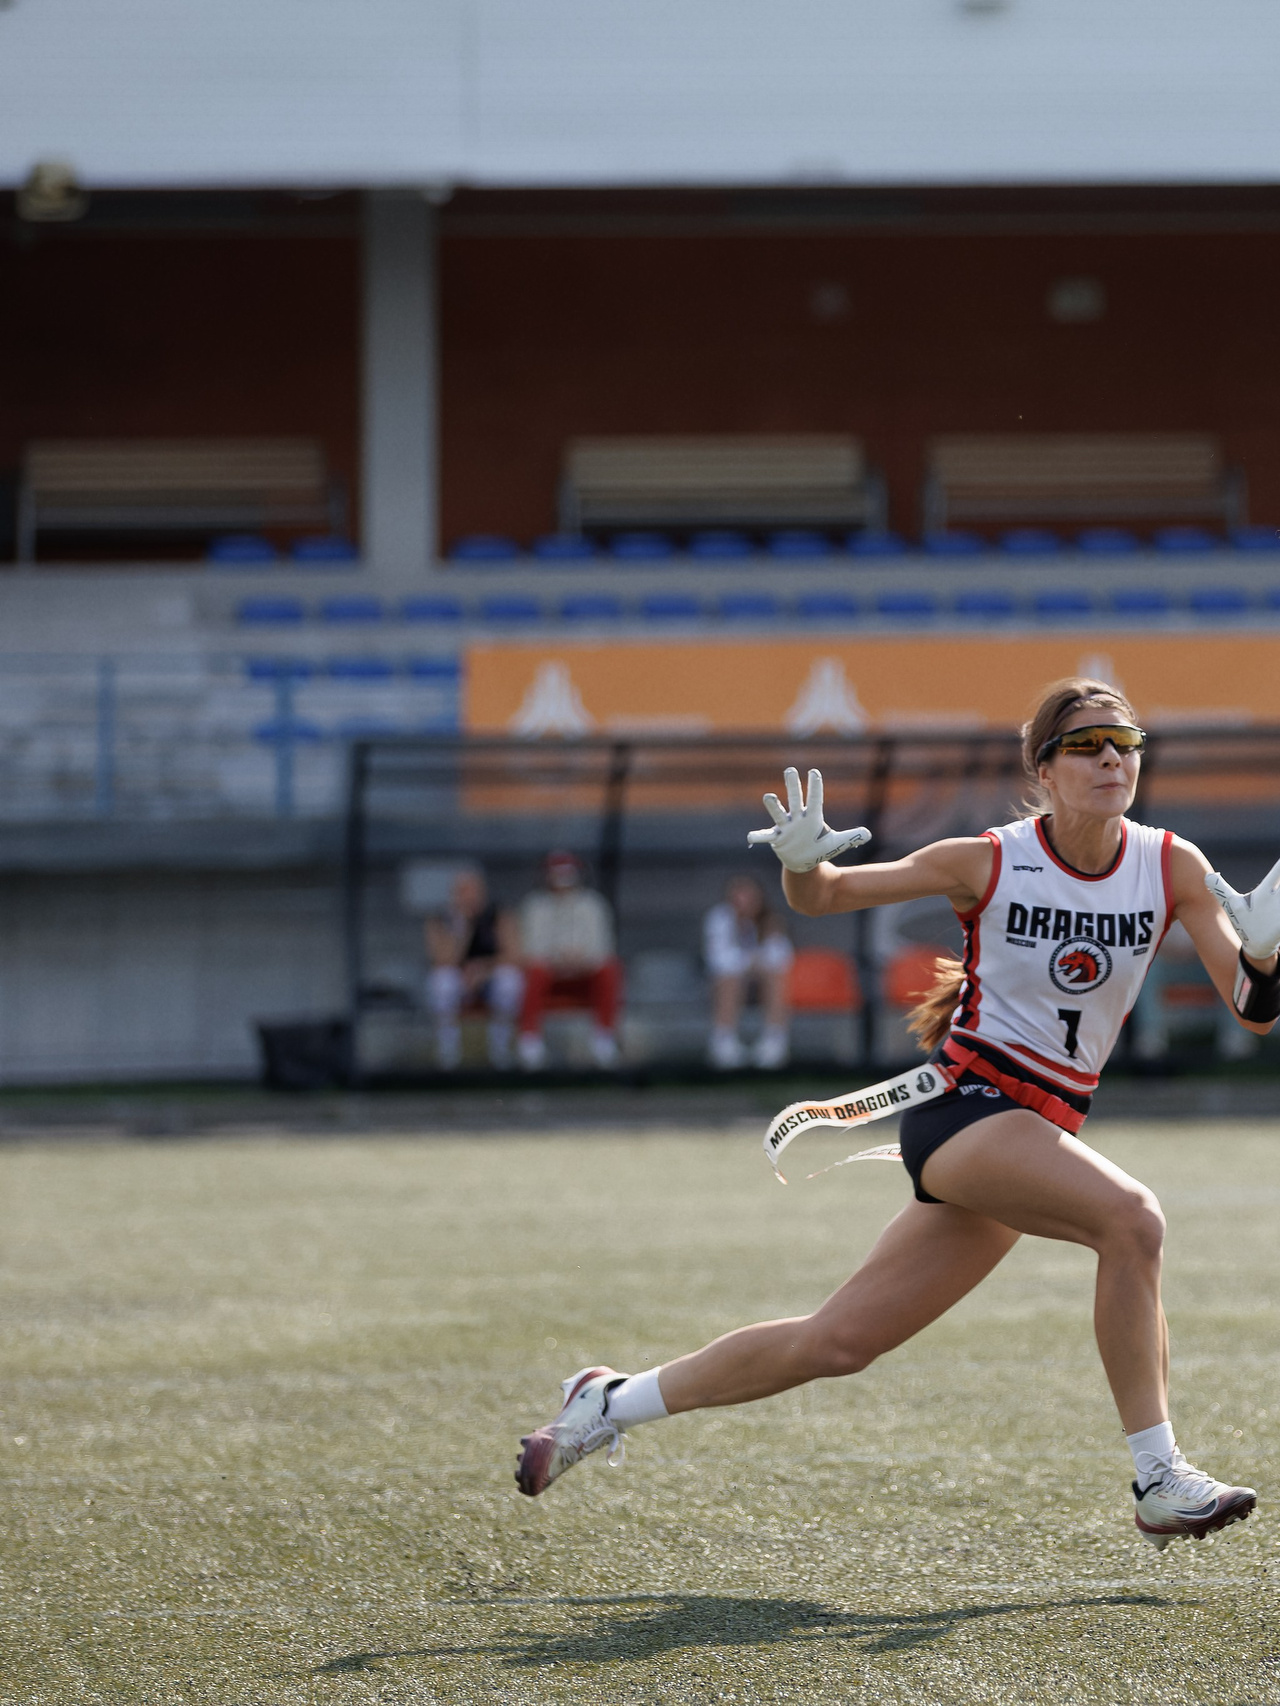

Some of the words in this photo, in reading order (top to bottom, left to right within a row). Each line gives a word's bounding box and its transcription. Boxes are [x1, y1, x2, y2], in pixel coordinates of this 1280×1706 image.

[1006, 902, 1154, 947] DRAGONS
[1058, 1008, 1082, 1059] 1
[769, 1108, 831, 1149] MOSCOW
[834, 1084, 911, 1120] DRAGONS
